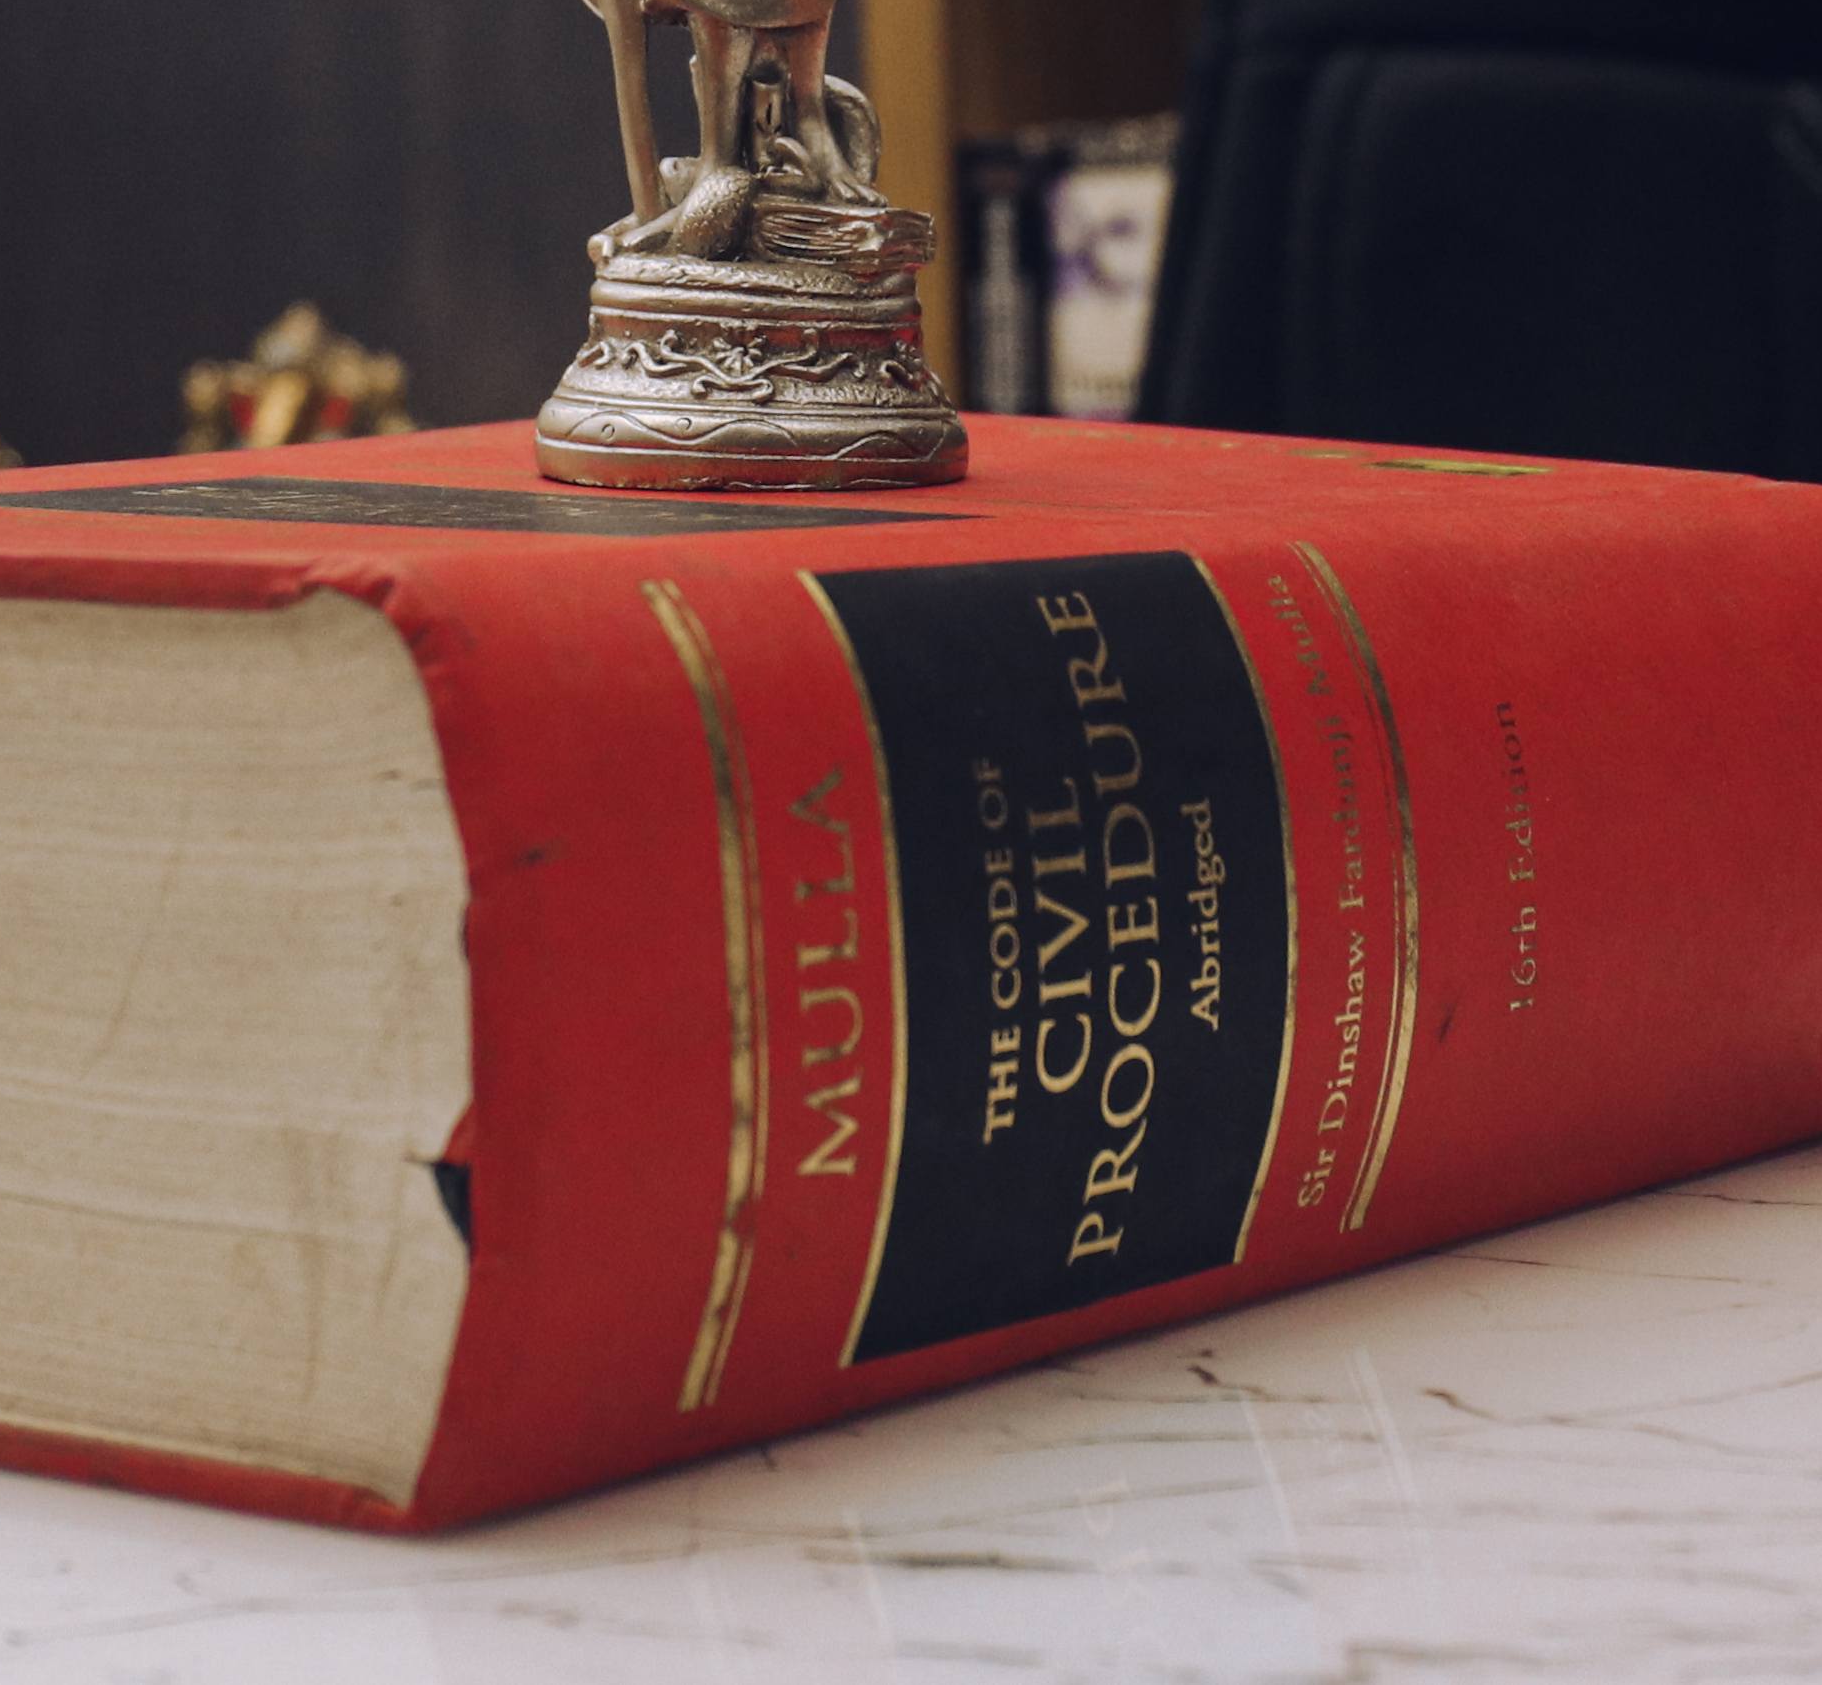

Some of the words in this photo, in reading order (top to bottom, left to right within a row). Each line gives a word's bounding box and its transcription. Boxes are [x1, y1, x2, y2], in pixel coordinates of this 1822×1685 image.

[1268, 574, 1334, 697] Mulla
[974, 758, 1009, 830] OF
[1317, 715, 1366, 910] Fardunji
[1495, 701, 1536, 882] Edition
[788, 763, 865, 1177] MULLA
[983, 846, 1023, 1010] CODE
[1027, 775, 1093, 1094] CIVIL
[1036, 590, 1161, 1266] PROCEDURE
[1180, 797, 1226, 1032] Abridged
[1509, 906, 1536, 1012] 16th
[983, 1024, 1022, 1145] THE
[1318, 930, 1367, 1136] Dinshaw
[1297, 1149, 1336, 1208] Sir
